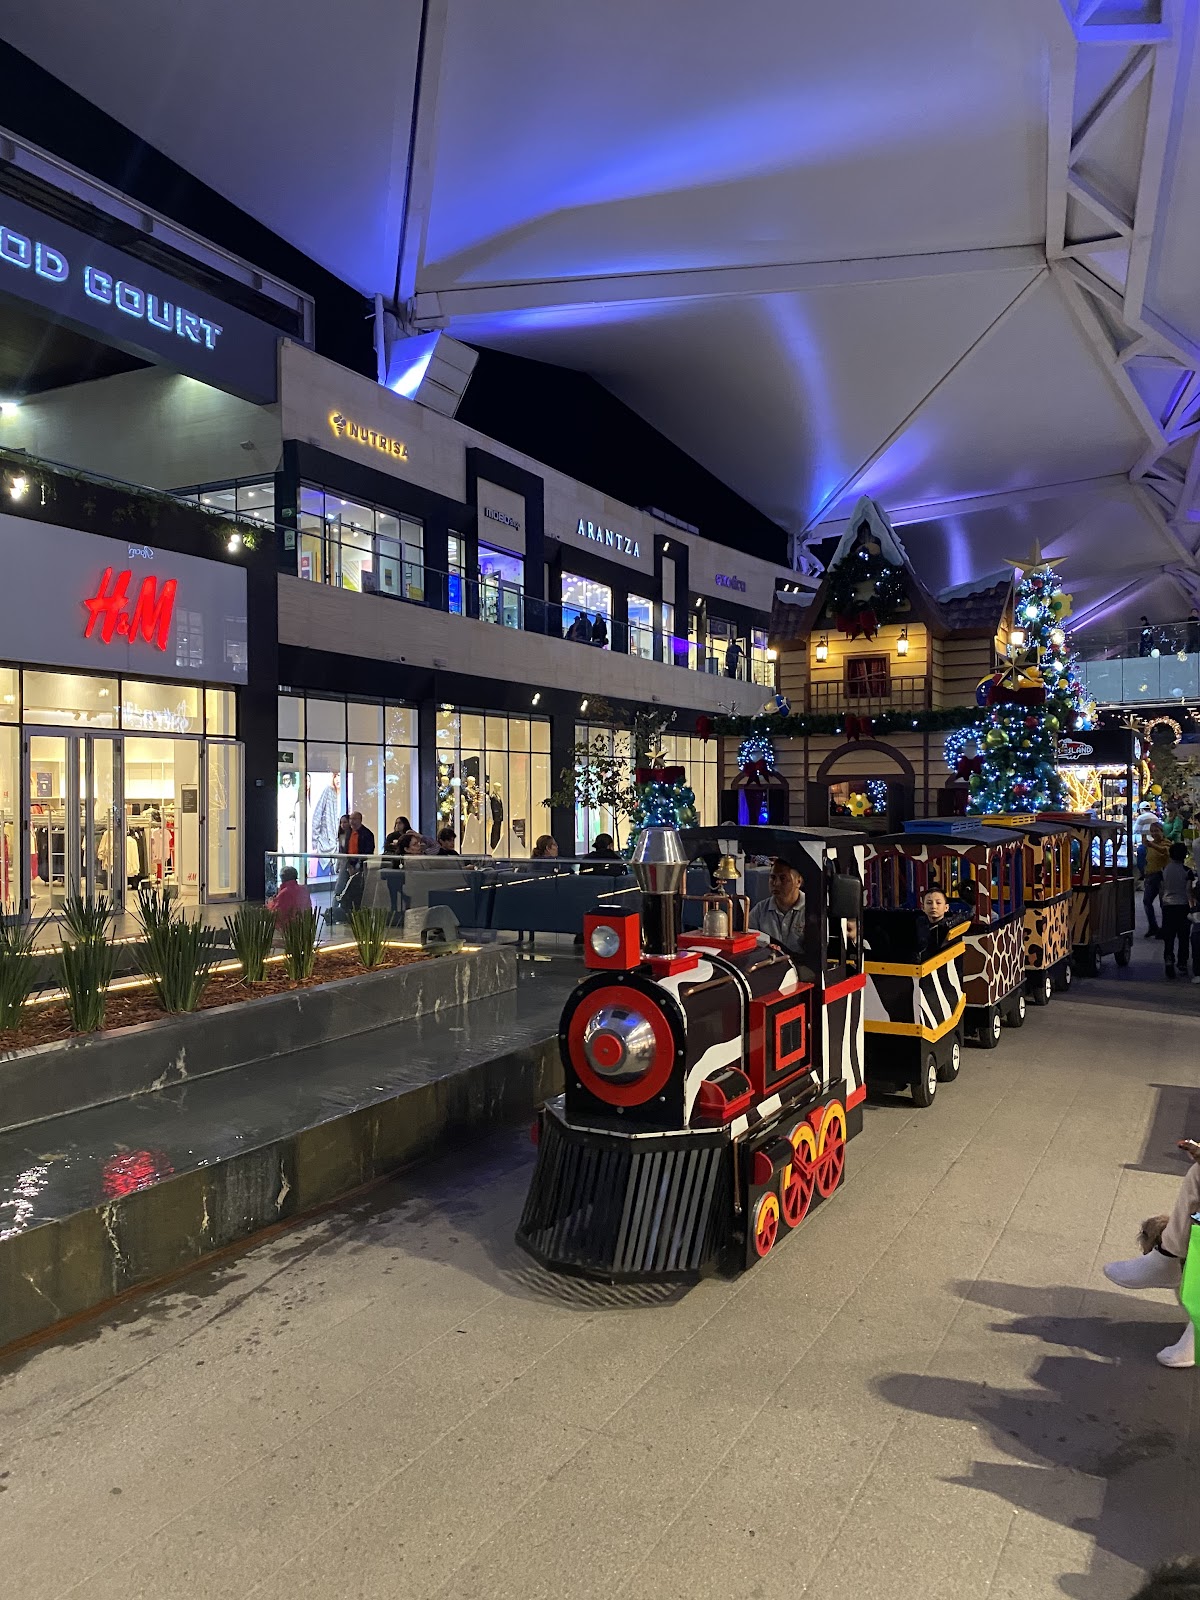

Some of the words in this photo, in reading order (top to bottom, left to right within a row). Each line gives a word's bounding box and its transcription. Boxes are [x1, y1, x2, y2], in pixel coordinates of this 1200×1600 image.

[84, 265, 223, 350] COURT
[348, 422, 409, 458] NUTRISA
[577, 518, 640, 558] ARANTZA
[84, 566, 177, 652] H&M
